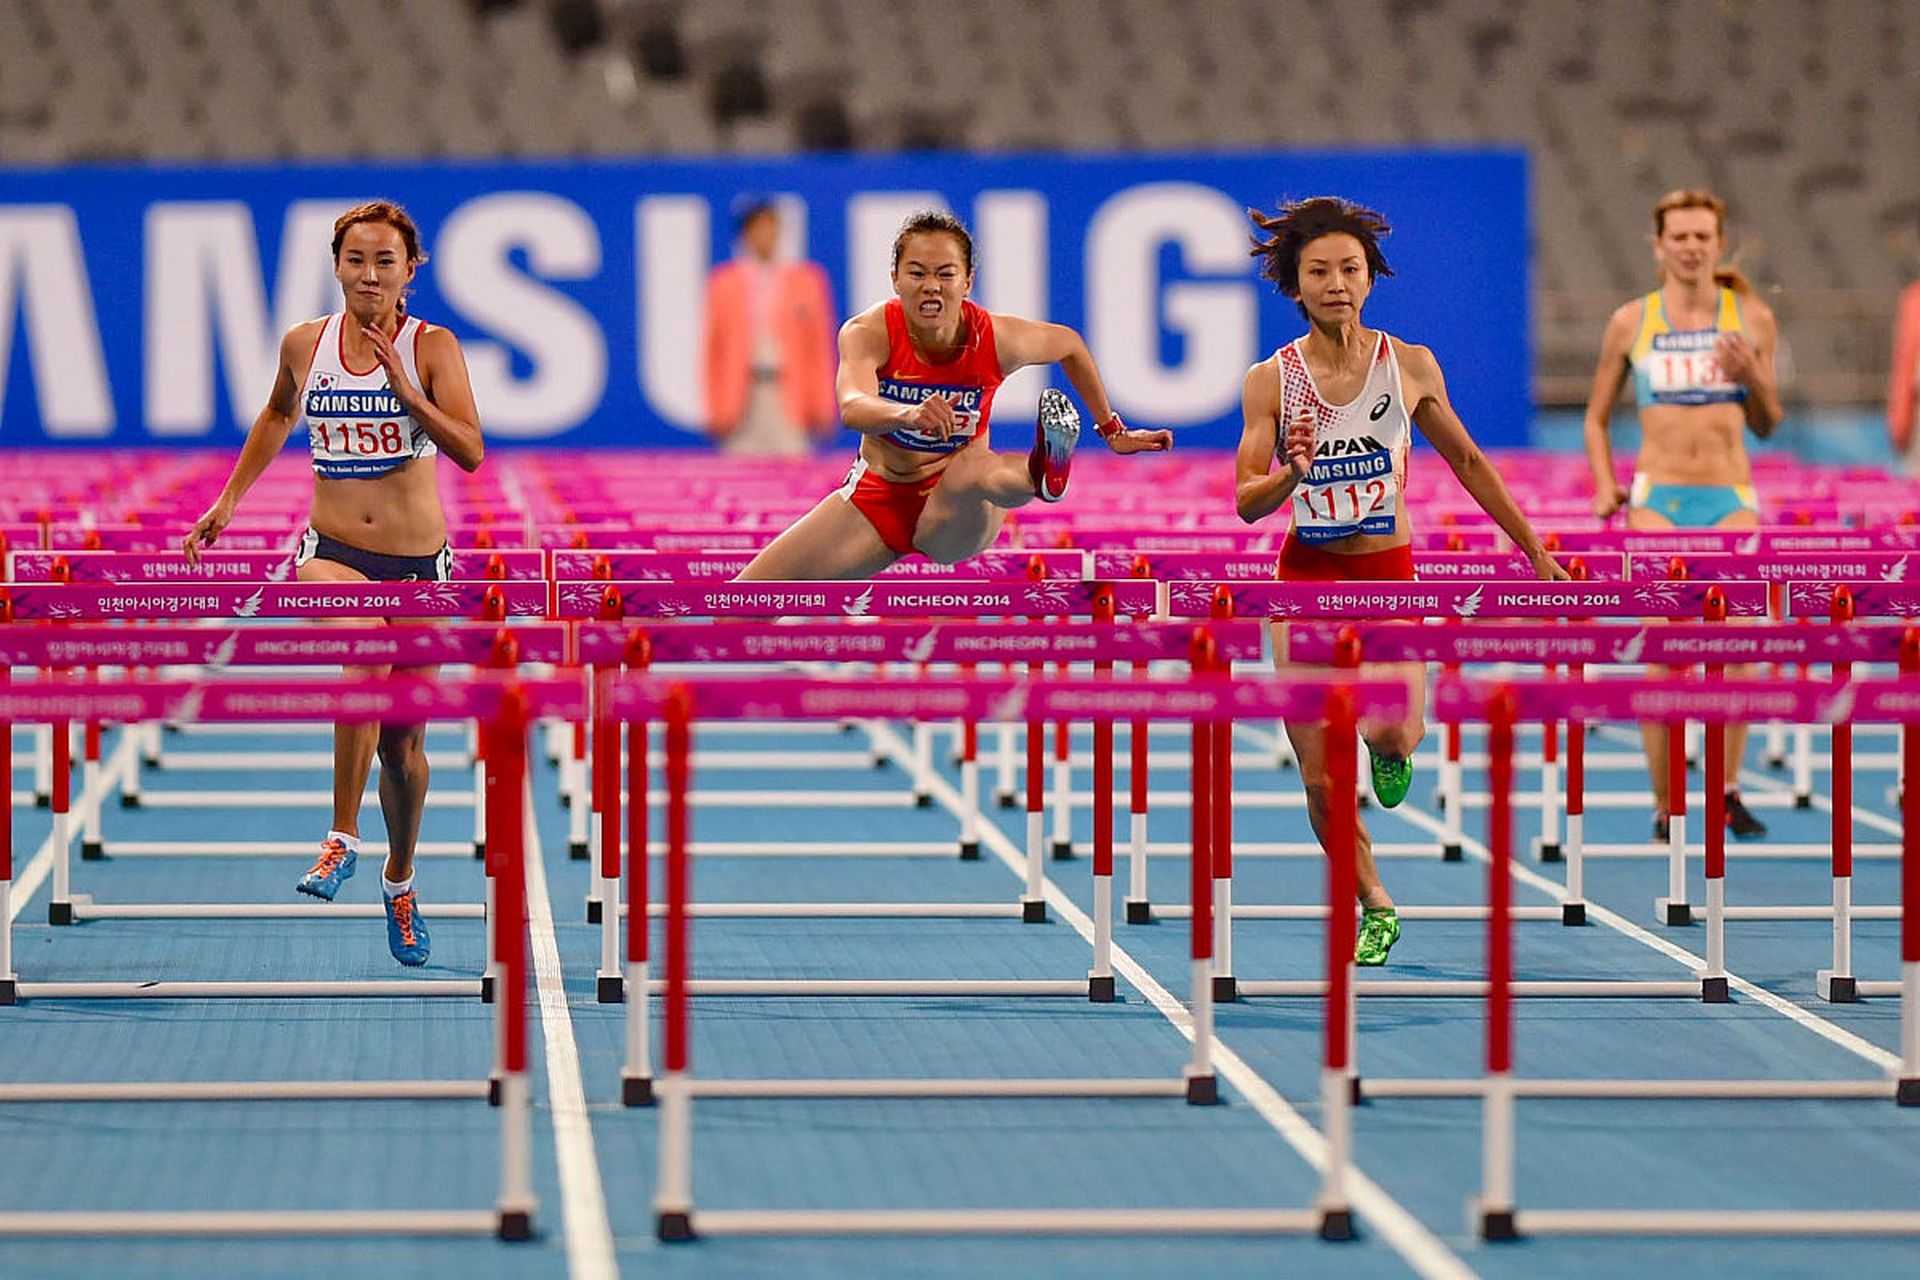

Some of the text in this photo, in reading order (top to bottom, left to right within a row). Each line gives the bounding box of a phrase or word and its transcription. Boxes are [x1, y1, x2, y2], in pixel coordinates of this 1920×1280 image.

[310, 396, 400, 413] SAMSUNG
[318, 422, 402, 454] 1158
[1315, 436, 1384, 457] APAN
[1306, 457, 1385, 481] MSUNG
[1301, 479, 1385, 520] 1112
[1415, 563, 1496, 575] HEON 2014
[97, 596, 402, 612] 인천아시아경기대회 INCHEON 2014
[703, 593, 1011, 610] 인천아시아경기대회 INCHEON 2014
[1316, 594, 1621, 611] 인천아시아경기대회 INCHEON 2014
